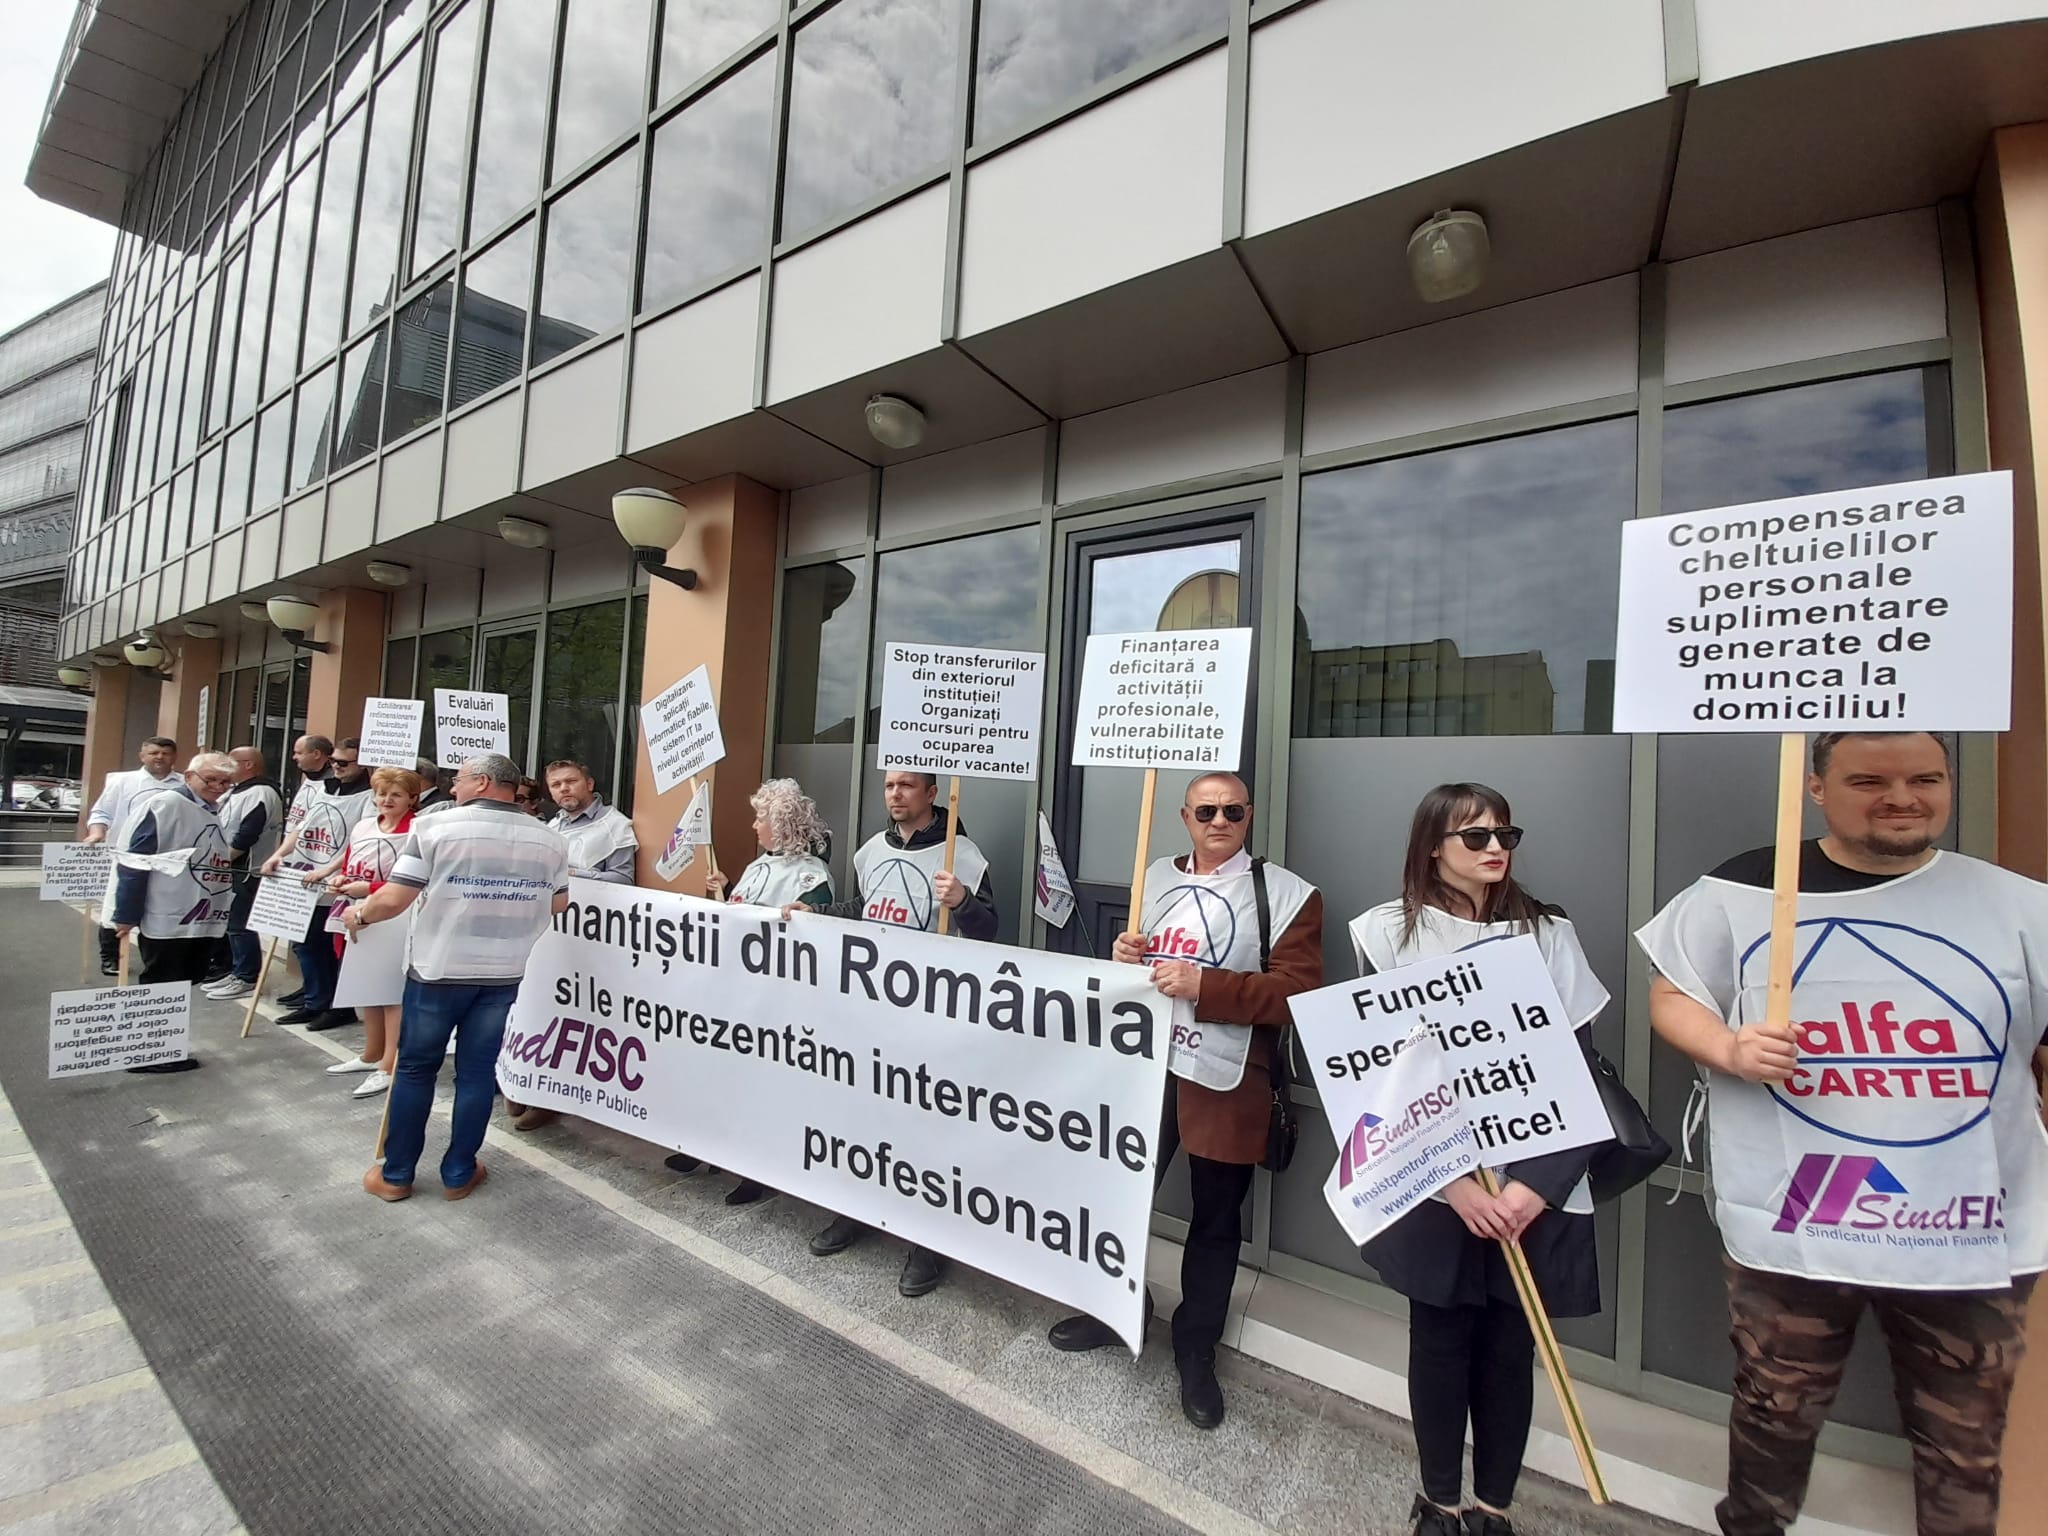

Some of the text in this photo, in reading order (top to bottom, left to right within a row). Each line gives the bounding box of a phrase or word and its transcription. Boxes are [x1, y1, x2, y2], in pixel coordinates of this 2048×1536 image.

[1668, 494, 1966, 547] Compensarea
[1680, 529, 1938, 575] cheltuielilor
[1700, 562, 1912, 607] personale
[1666, 596, 1949, 636] suplimentare
[1121, 638, 1220, 656] Finanțarea
[1678, 627, 1931, 668] generate de
[893, 648, 1038, 672] Stop transferurilor
[1109, 658, 1217, 675] deficitară a
[912, 668, 1016, 687] din exteriorul
[1704, 661, 1897, 691] munca la
[655, 679, 696, 712] Digitalizare,
[923, 685, 1002, 706] instituției!
[1116, 680, 1204, 700] activității
[449, 695, 495, 712] Evaluări
[663, 699, 690, 722] aplicații
[921, 701, 1001, 723] Organizați
[1097, 701, 1220, 720] profesionale,
[1692, 693, 1907, 721] domiciliu!
[437, 715, 507, 732] profesionale
[648, 701, 713, 748] informatice fiabile,
[890, 719, 1030, 742] concursuri pentru
[1090, 722, 1225, 741] vulnerabilitate
[450, 735, 496, 750] corecte/
[663, 734, 686, 754] sistem
[694, 723, 703, 736] la
[922, 738, 995, 756] ocuparea
[657, 731, 715, 773] nivelul cerințelor
[884, 752, 1031, 775] posturilor vacante!
[1089, 744, 1220, 764] instituțională!
[868, 897, 908, 923] alfa
[1145, 927, 1200, 954] alfa
[95, 988, 151, 1001] dialogul!
[741, 921, 818, 986] din
[840, 934, 1155, 1060] România
[1352, 961, 1483, 1021] Funcții
[54, 1018, 71, 1026] cu
[75, 1014, 116, 1024] Venim
[117, 1022, 133, 1030] pe
[136, 1018, 169, 1028] celor
[1512, 1001, 1550, 1033] la
[1796, 1001, 1957, 1055] alfa
[84, 1025, 113, 1034] care
[127, 1032, 143, 1040] cu
[54, 1035, 123, 1051] angajatorii
[90, 1041, 166, 1056] responsabil
[56, 1057, 111, 1072] partener
[123, 1049, 183, 1065] SindFISC
[555, 973, 1147, 1173] si le reprezentăm interesele
[1784, 1067, 1990, 1099] CARTEL
[597, 1089, 648, 1120] Publice
[1367, 1084, 1453, 1156] SindFISC
[1470, 1100, 1566, 1151] ifice!
[1380, 1152, 1471, 1217] www.sindfisc.ro
[803, 1125, 1136, 1295] profesionale.
[1805, 1225, 1881, 1245] Sindicatul
